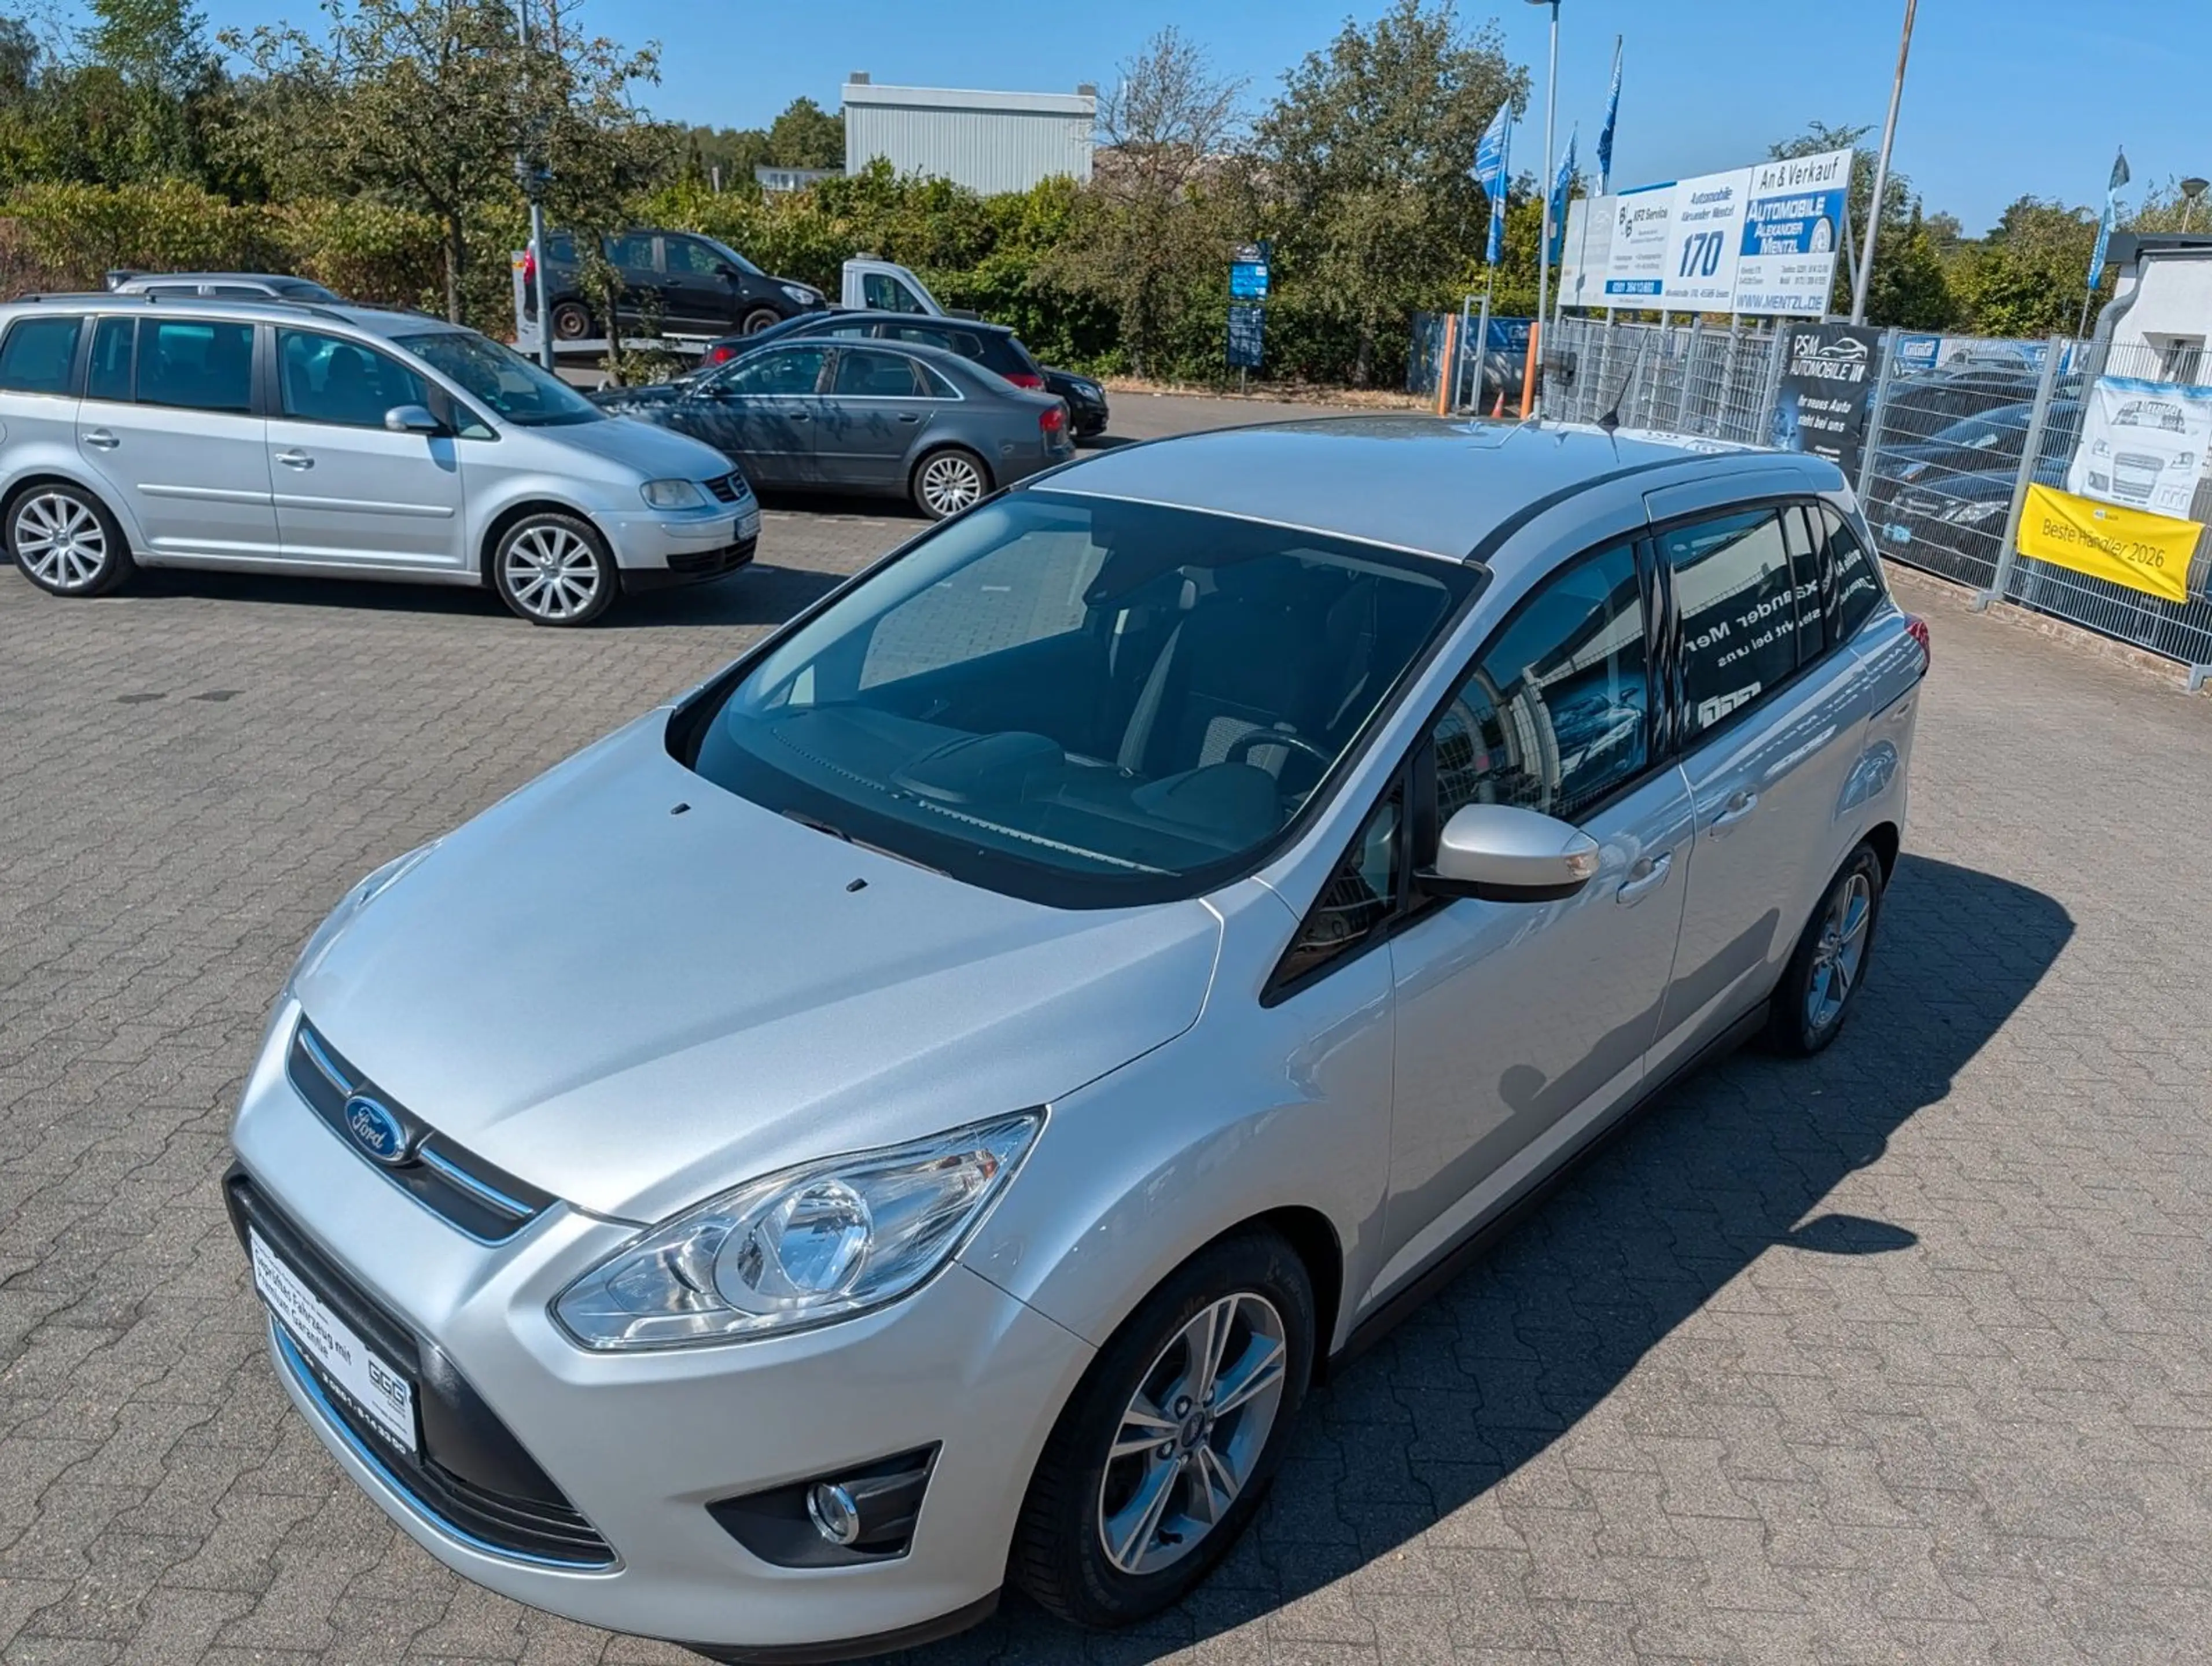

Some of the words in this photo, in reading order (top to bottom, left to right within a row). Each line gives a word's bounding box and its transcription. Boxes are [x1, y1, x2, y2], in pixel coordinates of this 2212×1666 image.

[1760, 169, 1775, 190] An
[1777, 166, 1786, 187] &
[1788, 156, 1839, 186] Verkauf
[1679, 230, 1724, 278] 170
[1794, 334, 1820, 357] PSM
[1828, 398, 1852, 414] Auto
[2042, 517, 2077, 544] Beste
[2078, 529, 2129, 557] Händler
[2128, 542, 2166, 569] 2026
[352, 1105, 388, 1149] Ford
[257, 1266, 290, 1315] Premium
[291, 1308, 330, 1359] Garantie
[292, 1287, 334, 1350] Fahrzeug
[335, 1340, 352, 1366] mit
